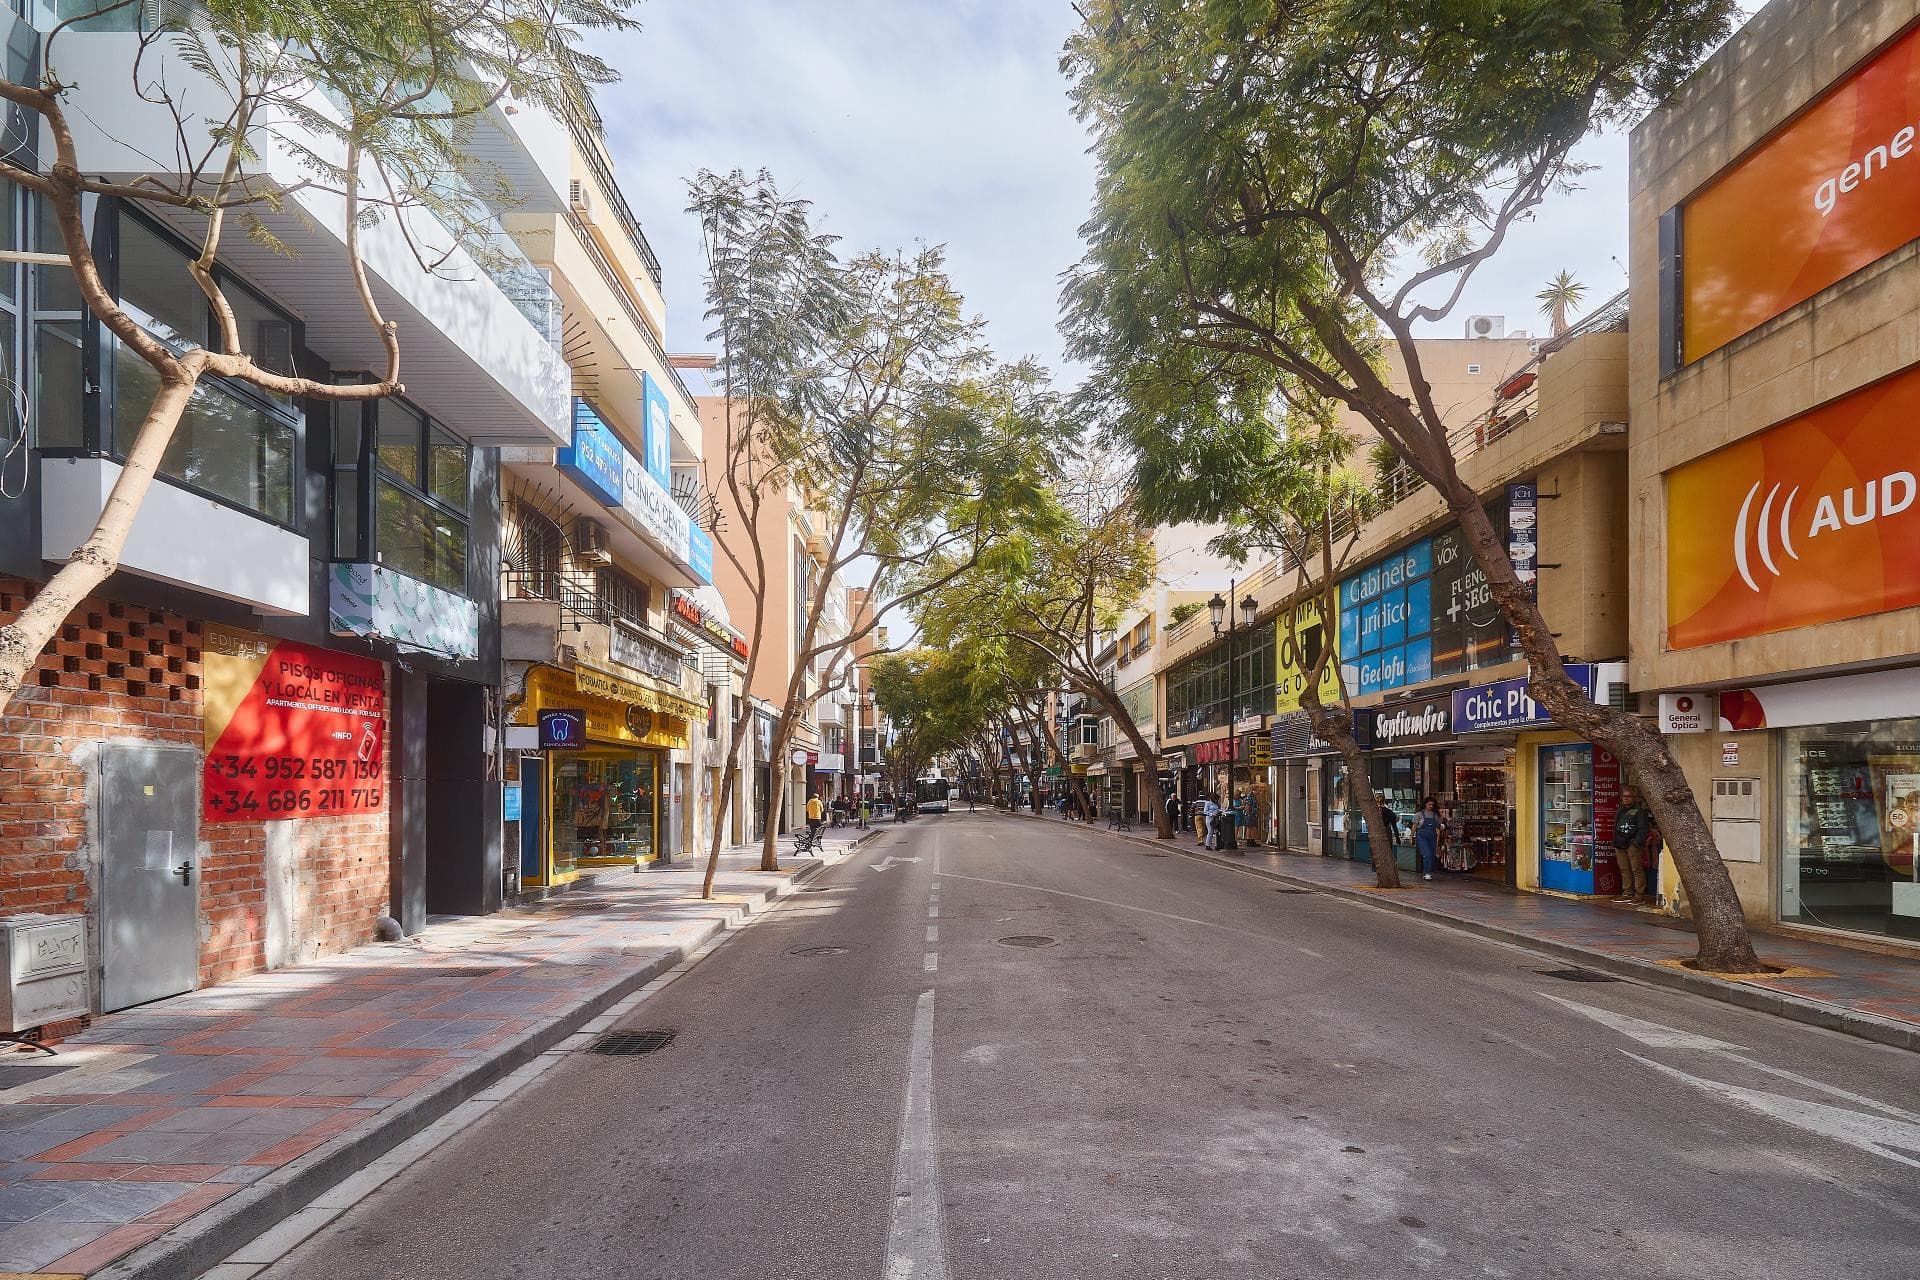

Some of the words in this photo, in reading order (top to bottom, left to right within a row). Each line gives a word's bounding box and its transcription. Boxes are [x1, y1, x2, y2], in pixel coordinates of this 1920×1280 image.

[1350, 558, 1416, 603] Gabinete
[1354, 602, 1411, 645] Jurídico
[279, 661, 324, 683] PISOS,
[326, 669, 381, 690] OFICINAS
[262, 680, 272, 695] Y
[276, 681, 321, 702] LOCAL
[324, 689, 341, 703] EN
[343, 691, 381, 708] VENTA
[308, 703, 330, 713] OFFICES
[330, 706, 342, 714] AND
[1465, 694, 1502, 721] Chic
[1668, 714, 1702, 722] General
[331, 731, 352, 740] +INFO
[1375, 704, 1448, 745] Septiembre
[1473, 719, 1508, 729] Complementos
[1671, 721, 1698, 730] Optica
[211, 755, 258, 779] +34
[264, 756, 305, 779] 952
[310, 758, 347, 779] 587
[352, 760, 381, 780] 130
[209, 790, 260, 814] +34
[268, 789, 311, 812] 686
[318, 789, 345, 810] 211
[351, 788, 380, 809] 715
